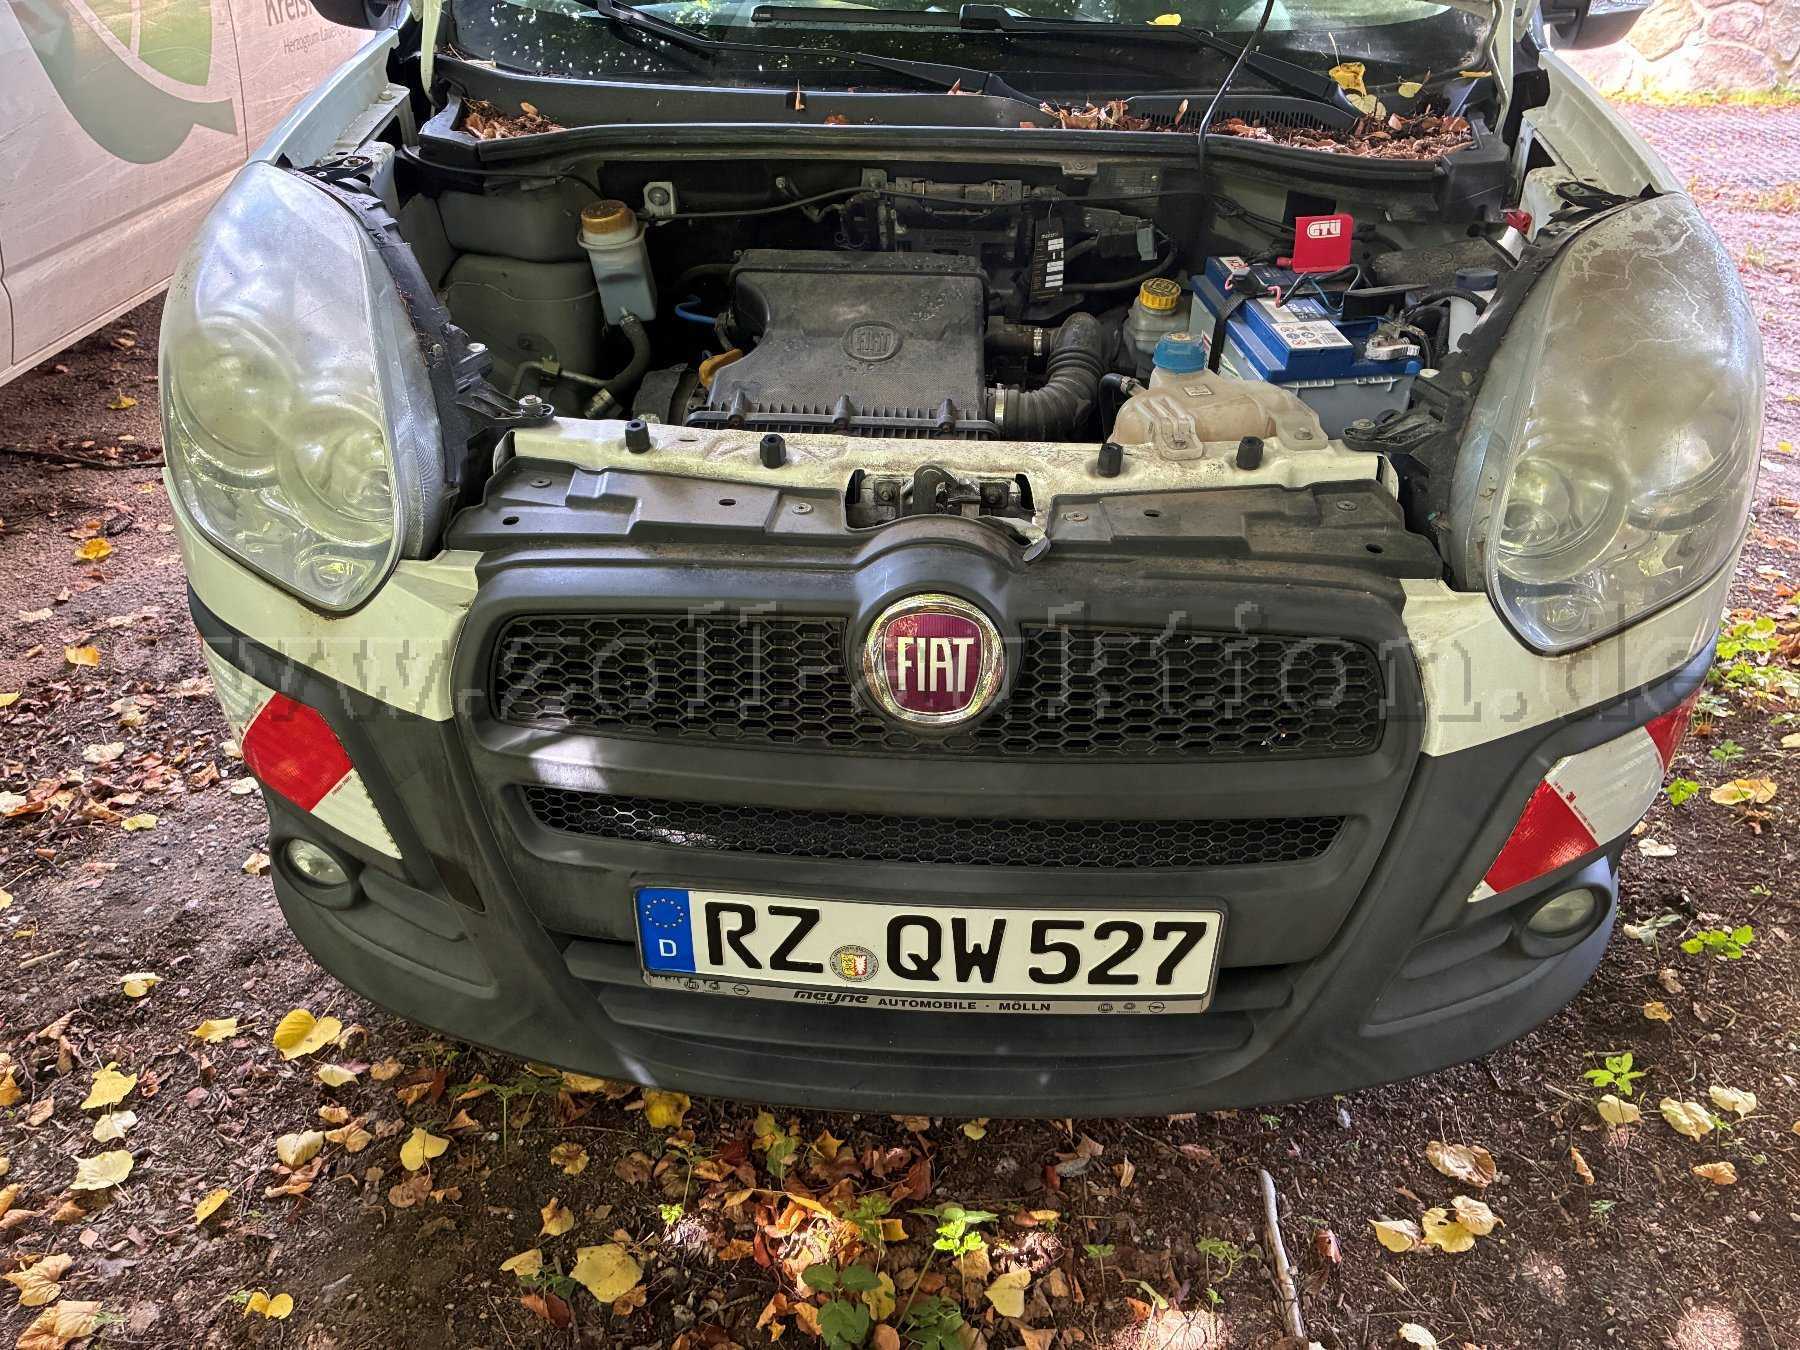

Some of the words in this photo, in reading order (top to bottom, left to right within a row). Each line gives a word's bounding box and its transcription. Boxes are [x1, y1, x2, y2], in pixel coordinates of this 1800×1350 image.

[897, 636, 975, 692] FIAT
[659, 938, 677, 957] D
[705, 901, 823, 973] RZ
[886, 914, 1007, 984] QW
[1028, 919, 1208, 986] 527
[792, 990, 870, 1005] meyne
[878, 997, 977, 1010] AUTOMOBILE
[998, 1000, 1051, 1011] MÖLLN
